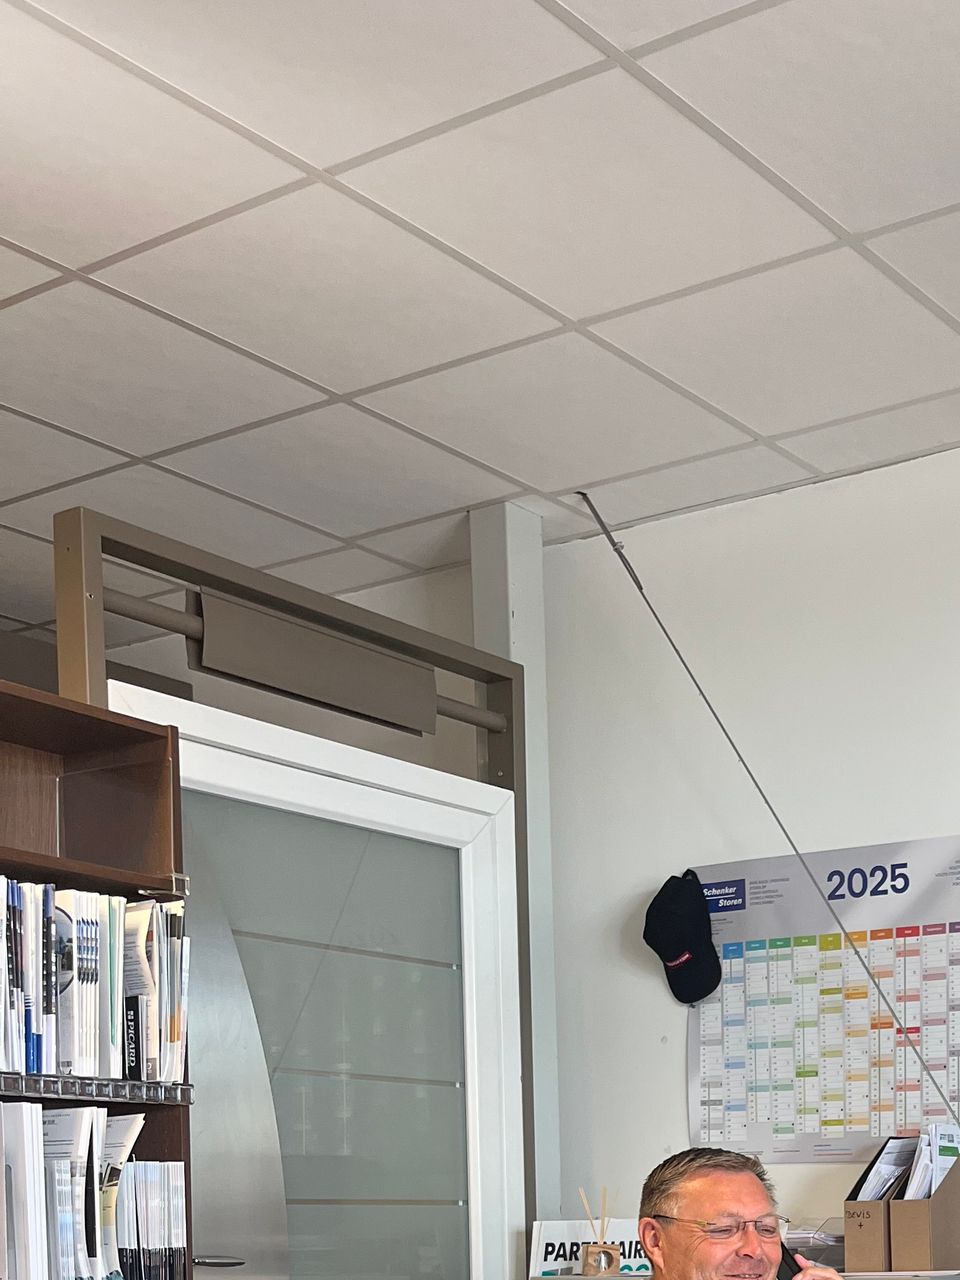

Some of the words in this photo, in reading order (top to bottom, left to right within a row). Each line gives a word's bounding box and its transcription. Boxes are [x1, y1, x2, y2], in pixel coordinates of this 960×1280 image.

[827, 862, 910, 900] 2025
[703, 886, 737, 896] Schenker
[718, 898, 743, 907] Storen
[127, 1021, 136, 1066] PICARD
[845, 1210, 872, 1219] DEVIS
[543, 1240, 648, 1262] PARAIR
